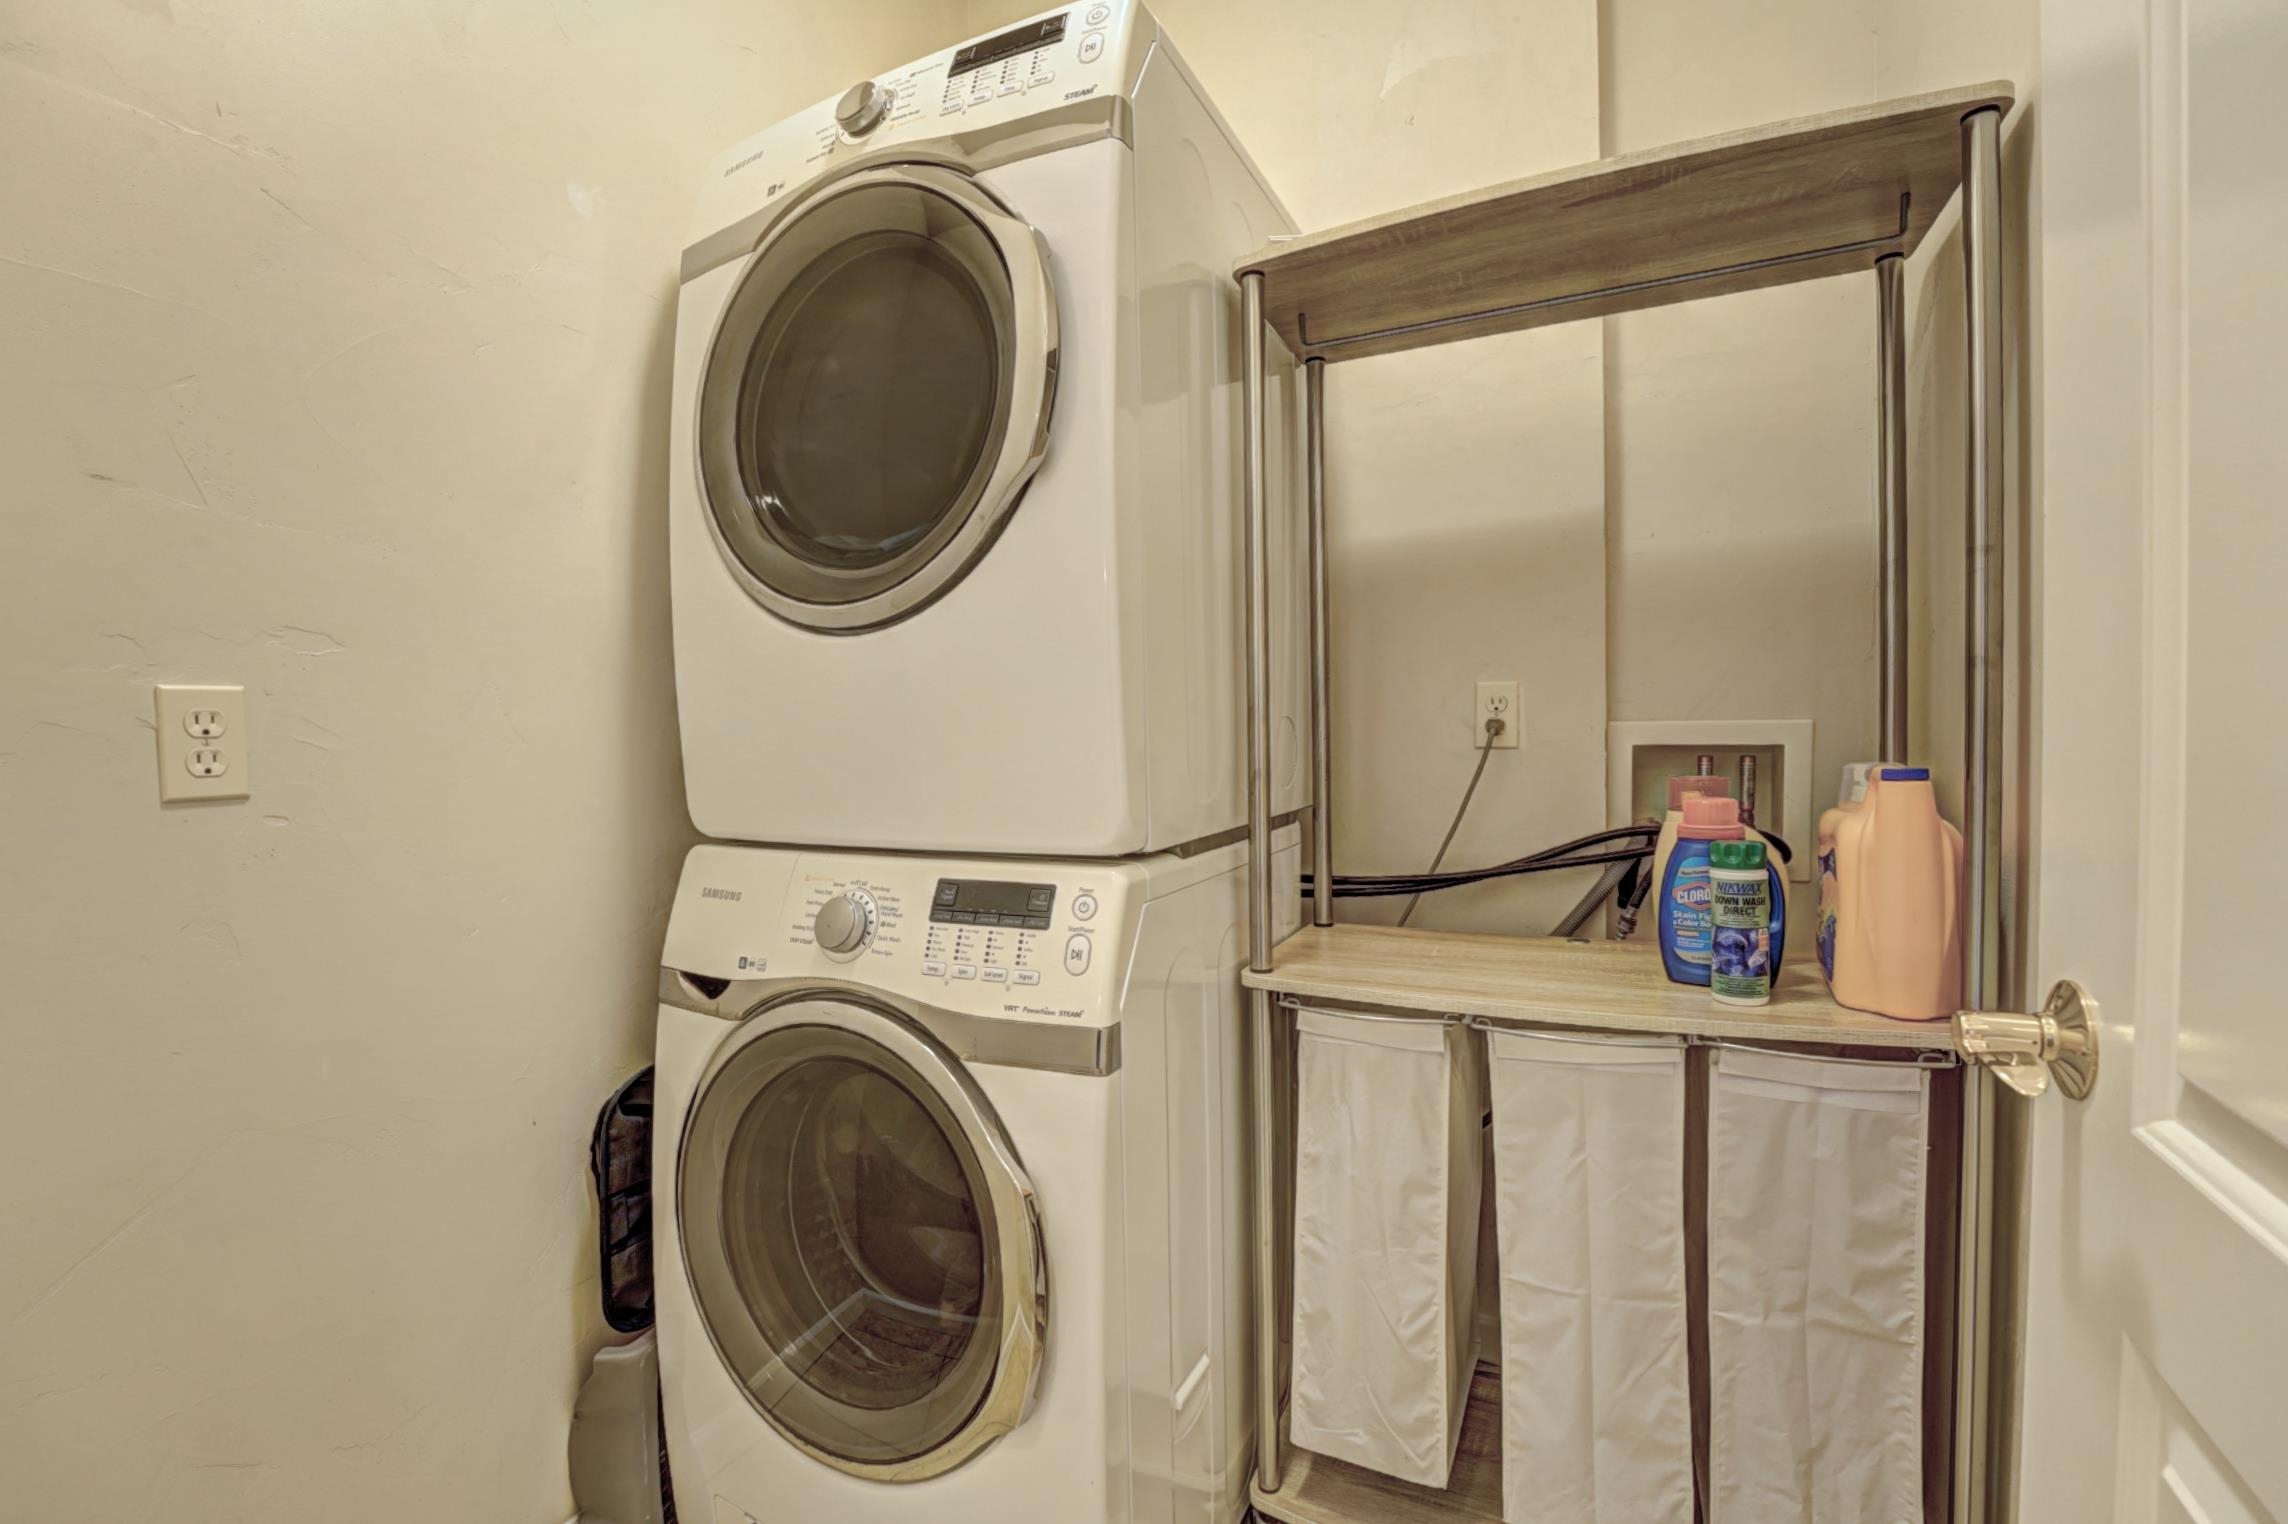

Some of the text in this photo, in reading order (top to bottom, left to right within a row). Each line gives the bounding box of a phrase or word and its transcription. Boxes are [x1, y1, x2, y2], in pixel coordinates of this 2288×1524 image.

[1064, 86, 1096, 101] STEAM
[1716, 881, 1762, 894] NIKWAX
[701, 887, 742, 902] SAMSUNG
[1677, 888, 1712, 904] CLORO
[1715, 894, 1766, 906] DOWN WASH
[1672, 910, 1697, 919] Stain
[1723, 906, 1757, 916] DIRECT
